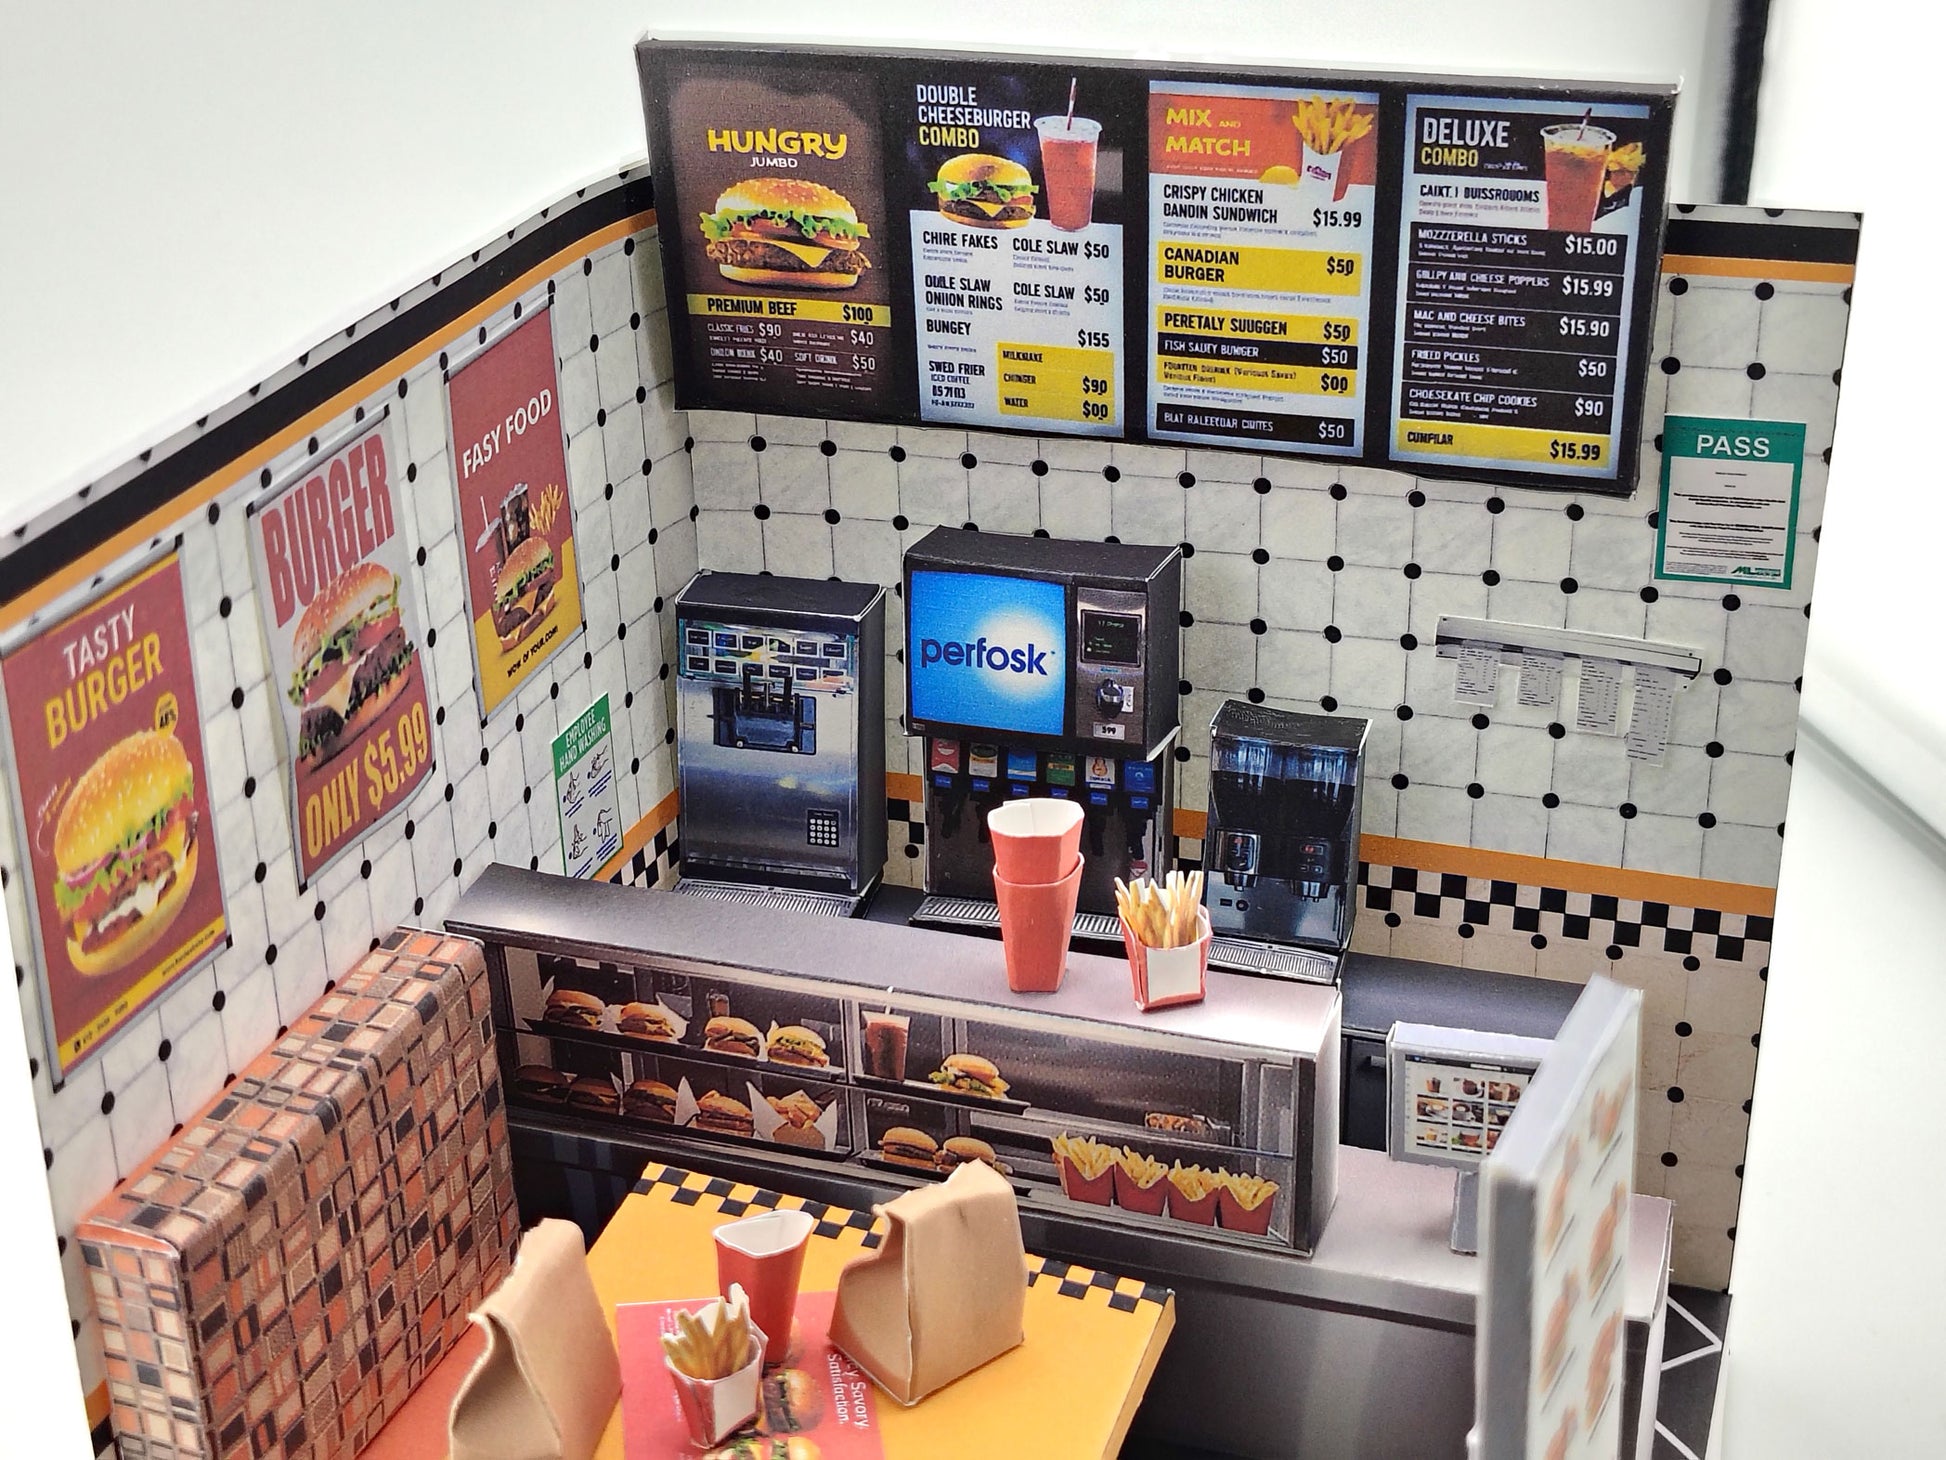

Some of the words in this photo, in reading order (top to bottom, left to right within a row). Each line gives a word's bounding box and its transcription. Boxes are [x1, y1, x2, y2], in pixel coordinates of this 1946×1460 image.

[916, 84, 978, 106] DOUBLE
[918, 105, 1031, 129] CHEESEBURGER
[1165, 107, 1212, 128] MIX
[1219, 119, 1242, 129] AND
[707, 128, 847, 160] HUNGRY
[919, 126, 979, 148] COMBO
[1423, 117, 1511, 148] DELUXE
[1165, 136, 1251, 157] MATCH
[1421, 147, 1479, 167] COMBO
[750, 157, 798, 168] JUMBO
[1164, 184, 1206, 201] CRISPY
[1211, 187, 1263, 204] CHICKEN
[1313, 208, 1362, 228] $15.99
[923, 231, 957, 247] CHIRE
[961, 234, 998, 250] FAKES
[1013, 237, 1043, 254] COLE
[1046, 240, 1079, 256] SLAW
[1083, 240, 1110, 260] $50
[1491, 233, 1528, 246] STICKS
[1564, 234, 1618, 256] $15.00
[1164, 247, 1239, 265] CANADIAN
[1327, 256, 1354, 276] $50
[1164, 265, 1225, 282] BURGER
[960, 277, 991, 292] SLAW
[1013, 281, 1040, 297] COLE
[1044, 284, 1075, 300] SLAW
[1084, 285, 1110, 305] $50
[1562, 276, 1614, 297] $15.99
[707, 297, 763, 314] PREMIUM
[769, 301, 797, 316] BEEF
[842, 304, 873, 322] $100
[968, 294, 1003, 311] RINGS
[759, 322, 781, 339] $90
[926, 318, 972, 336] BUNGEY
[1078, 329, 1110, 348] $155
[1165, 313, 1225, 331] PERETALY
[1323, 321, 1350, 341] $50
[1413, 309, 1434, 320] MAC
[1437, 311, 1457, 322] AND
[1460, 312, 1496, 325] CHEESE
[1498, 315, 1526, 327] BITES
[1559, 316, 1610, 338] $15.90
[850, 329, 874, 348] $40
[760, 347, 783, 365] $40
[852, 353, 876, 371] $50
[1164, 340, 1185, 351] FISH
[1322, 346, 1348, 364] $50
[1443, 351, 1480, 363] PICKLES
[1578, 358, 1607, 378] $50
[1082, 376, 1108, 396] $90
[1321, 373, 1348, 394] $00
[505, 388, 551, 444] FOOD
[1082, 400, 1108, 420] $00
[1473, 393, 1495, 404] CHIP
[1498, 395, 1538, 407] COOKIES
[1575, 397, 1604, 417] $90
[1318, 421, 1345, 439] $50
[1550, 439, 1601, 461] $15.99
[1696, 434, 1770, 458] PASS
[261, 433, 395, 628] BURGER
[62, 603, 135, 680] TASTY
[921, 637, 1048, 676] perfosk
[45, 632, 164, 749] BURGER
[566, 708, 596, 748] EMPLOYEE
[560, 745, 578, 773] HAND
[578, 717, 606, 754] WASHING
[306, 757, 360, 858] ONLY
[363, 702, 428, 811] $5.99
[851, 1381, 870, 1428] Savory
